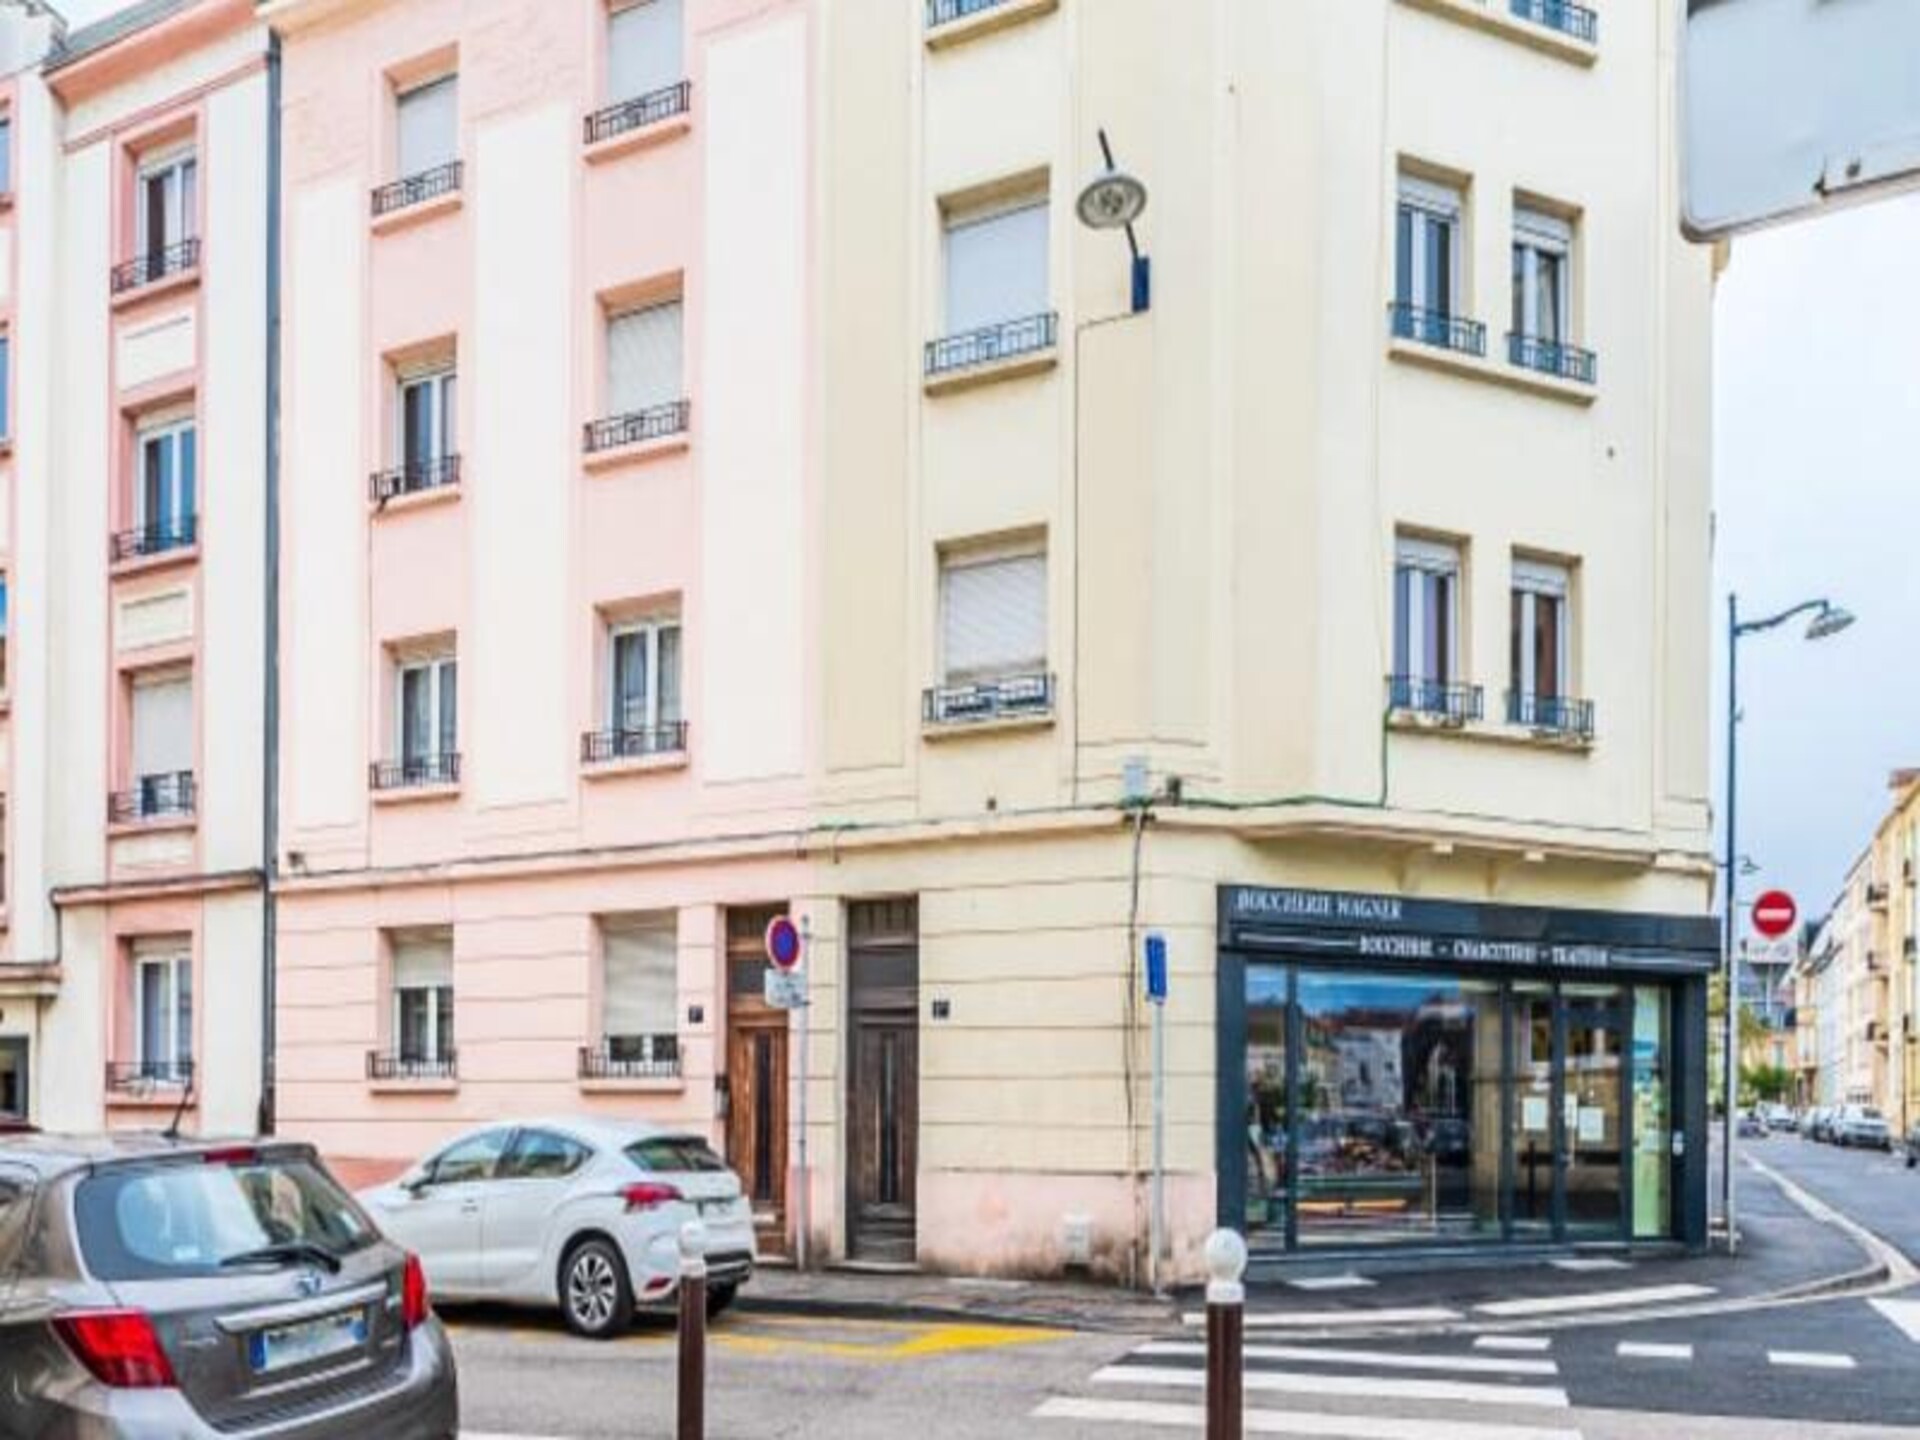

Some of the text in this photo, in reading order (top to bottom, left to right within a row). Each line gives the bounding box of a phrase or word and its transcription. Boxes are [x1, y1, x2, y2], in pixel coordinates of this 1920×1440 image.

[1237, 888, 1402, 920] BOUCHERIE WAGNER
[1360, 935, 1434, 957] BOUCHERIE
